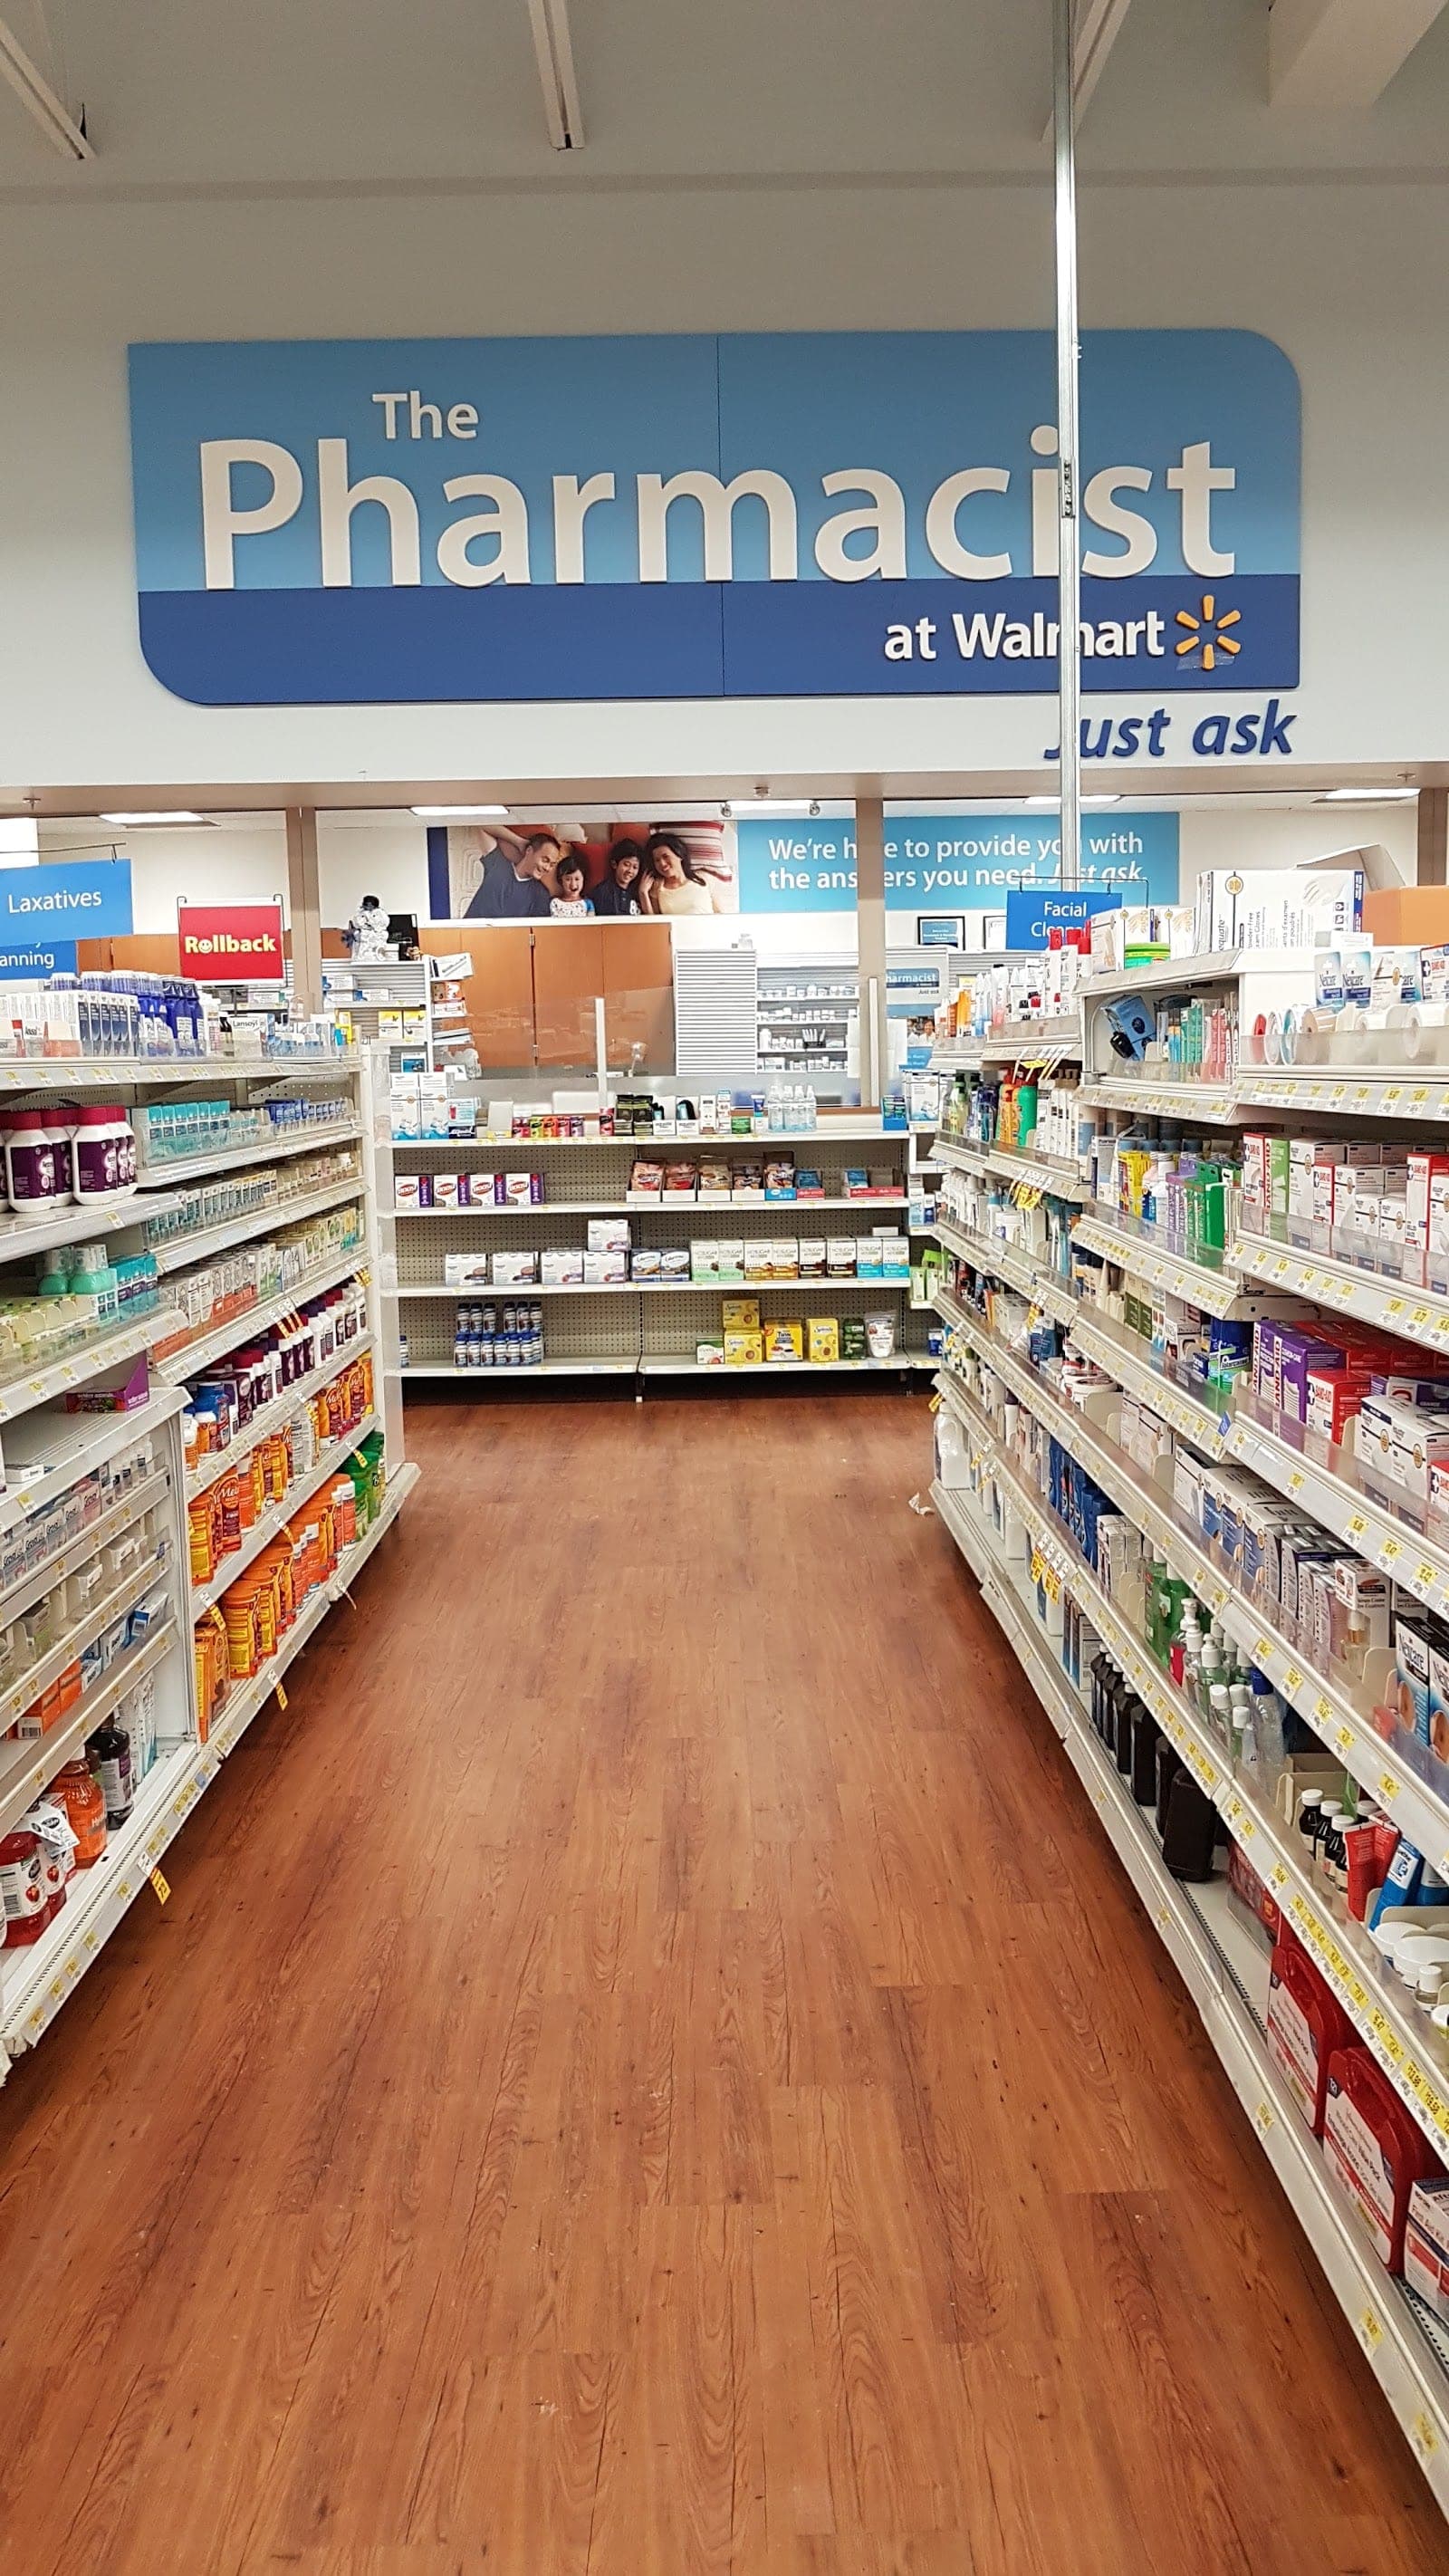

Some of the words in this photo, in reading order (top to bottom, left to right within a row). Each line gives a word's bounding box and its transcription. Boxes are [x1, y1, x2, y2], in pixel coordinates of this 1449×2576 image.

[371, 389, 480, 441] The
[199, 424, 1236, 591] Pharmacist
[884, 617, 936, 660] at
[1192, 699, 1298, 755] ask
[768, 838, 837, 860] We're
[842, 837, 897, 859] he
[904, 839, 930, 858] to
[936, 834, 1031, 863] provide
[1037, 839, 1081, 860] yo
[1089, 831, 1144, 854] with
[769, 867, 811, 889] the
[817, 870, 916, 889] ansers
[922, 868, 968, 893] you
[975, 862, 1041, 886] need.
[1047, 862, 1097, 885] Jst
[7, 889, 102, 914] Laxatives
[1043, 901, 1088, 918] Facial
[184, 932, 277, 955] Rollback
[885, 972, 936, 983] harmacist
